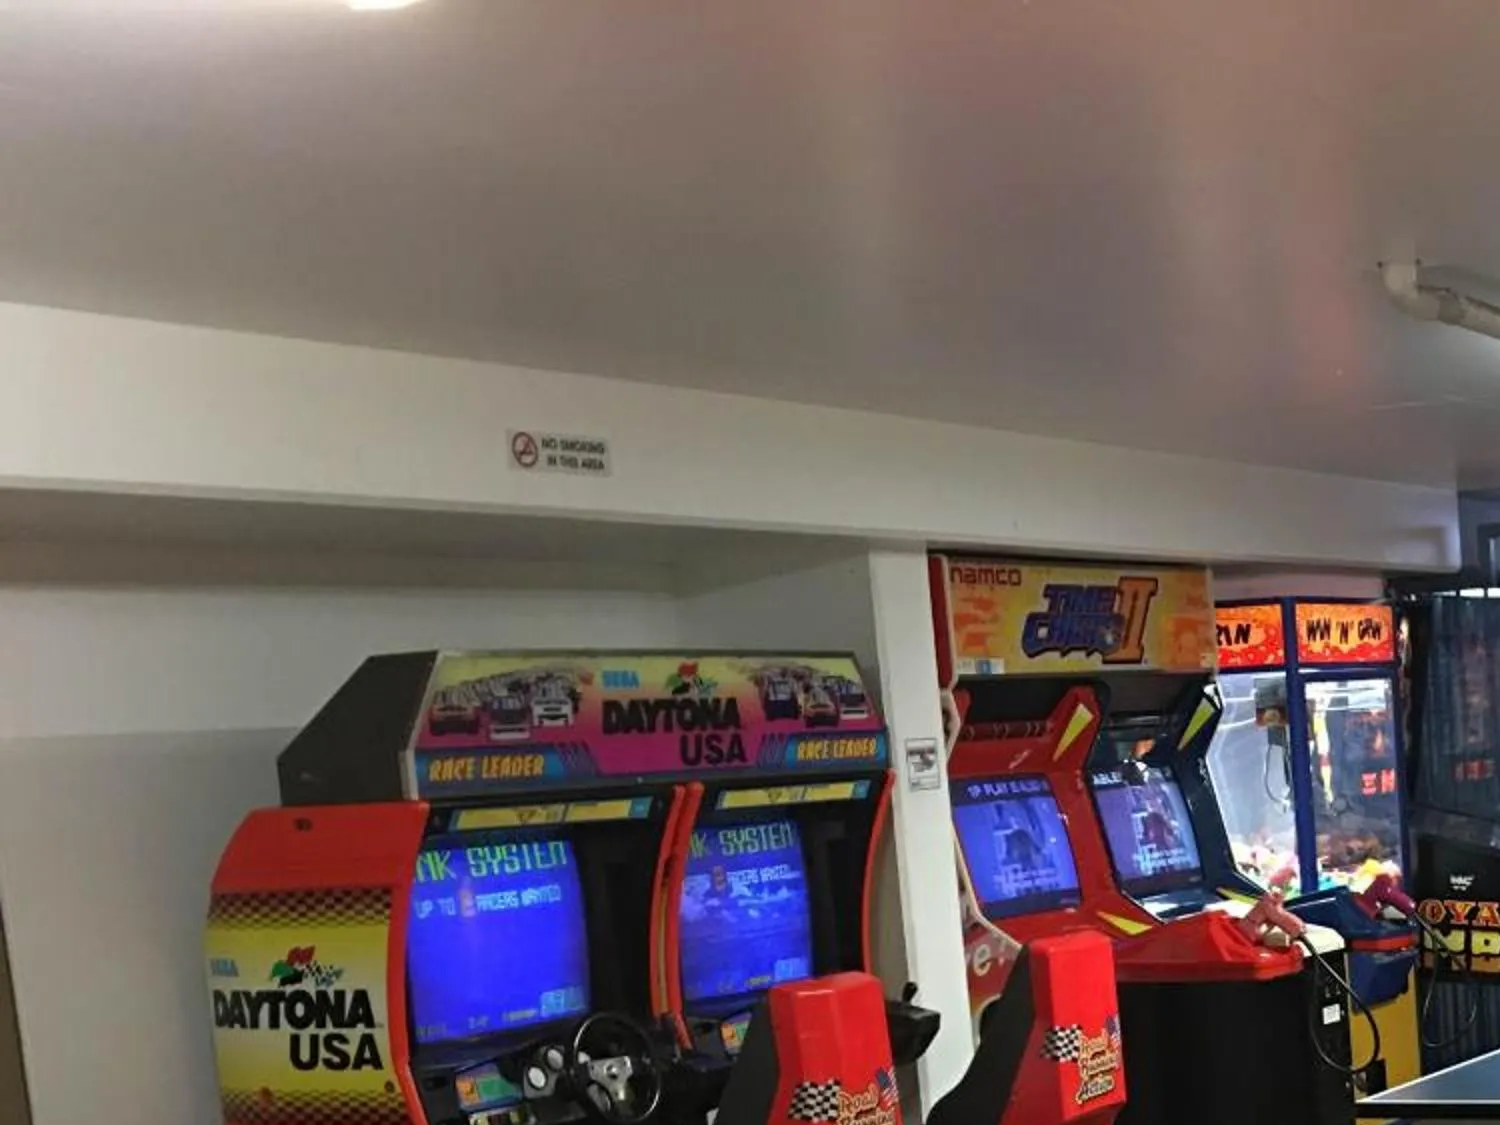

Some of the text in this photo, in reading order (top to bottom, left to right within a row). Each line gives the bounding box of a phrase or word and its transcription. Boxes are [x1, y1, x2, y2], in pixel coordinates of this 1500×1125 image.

[541, 437, 605, 454] NO SMOKING
[546, 455, 557, 466] IN
[581, 457, 605, 470] AREA
[951, 566, 1021, 586] namco
[1216, 623, 1252, 646] RIN
[602, 669, 639, 689] SEGA
[602, 698, 742, 735] DAYTONA
[680, 732, 748, 767] USA
[797, 738, 876, 760] RACE LEADER
[429, 753, 545, 782] RACE LEADER
[719, 821, 795, 857] SYSTEM
[412, 841, 568, 884] NK SYSTEM
[213, 989, 375, 1030] DAYTONA
[289, 1033, 384, 1071] USA
